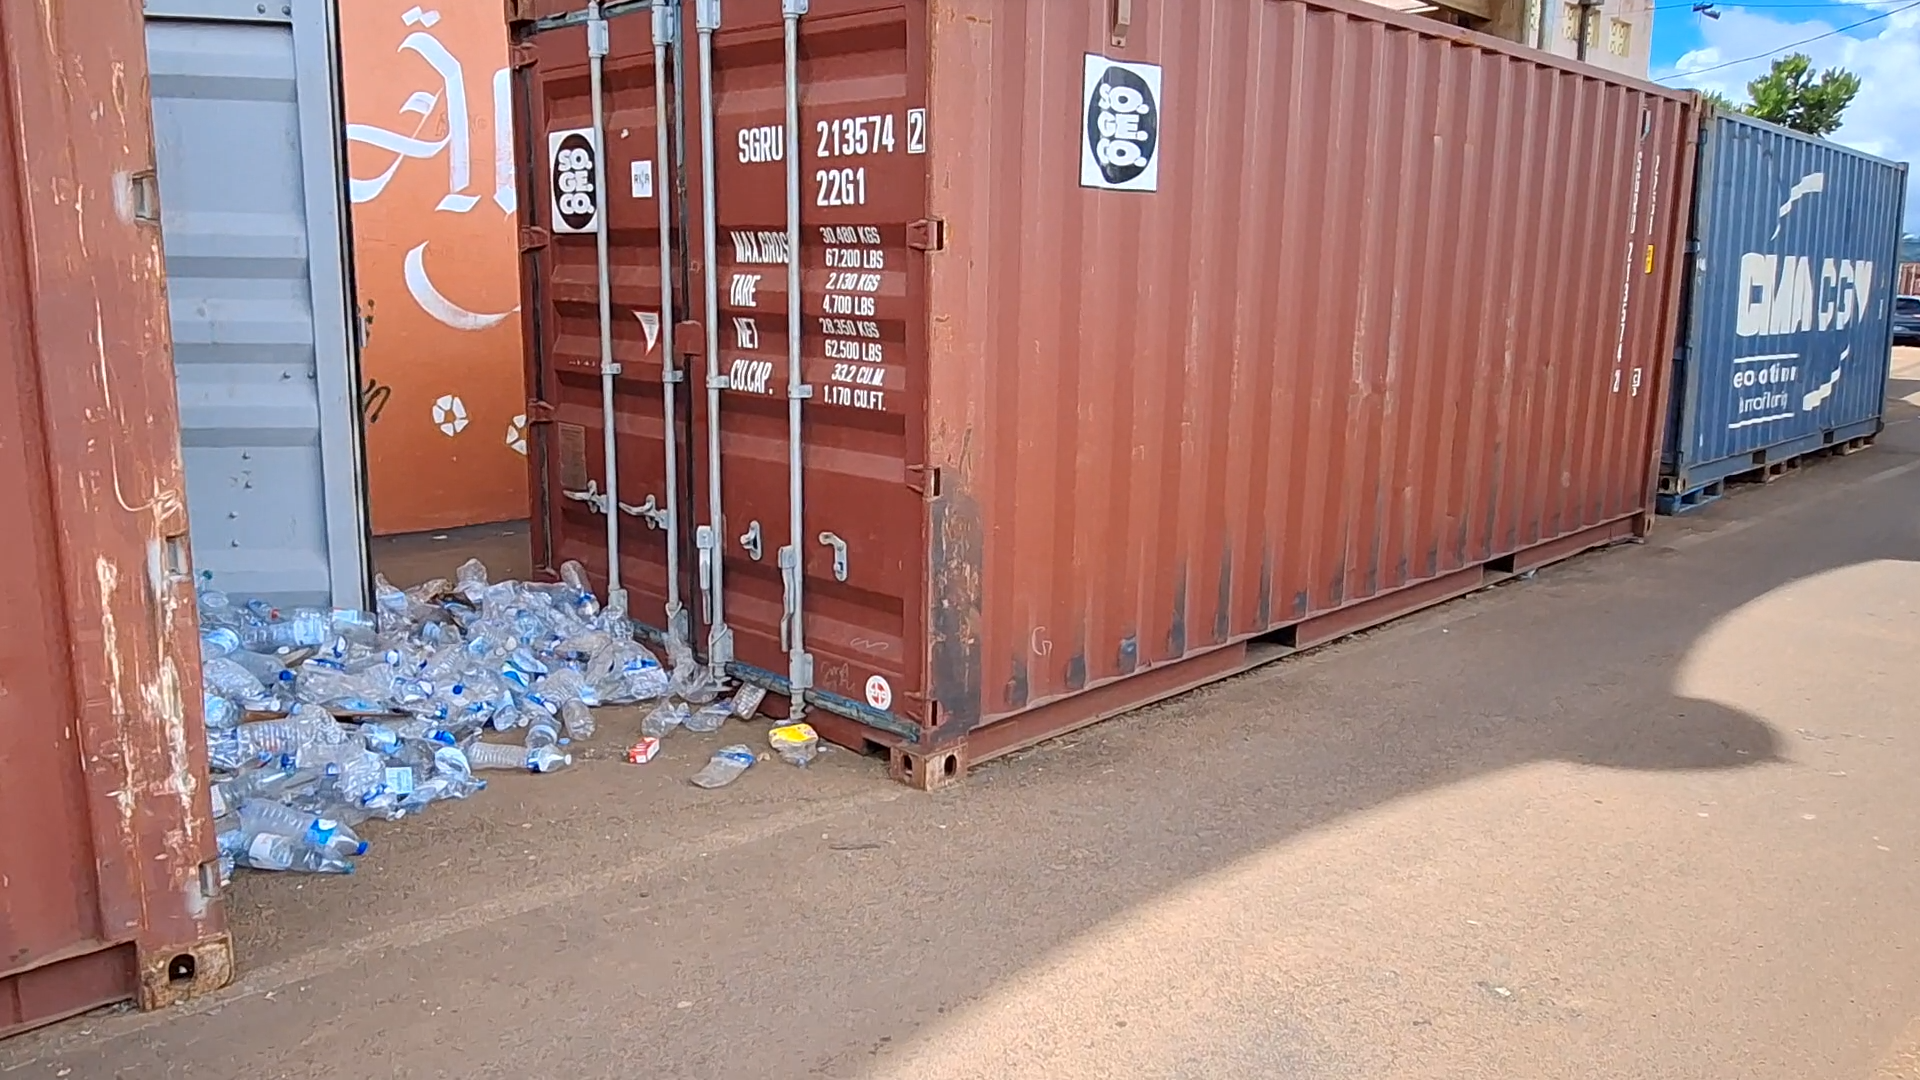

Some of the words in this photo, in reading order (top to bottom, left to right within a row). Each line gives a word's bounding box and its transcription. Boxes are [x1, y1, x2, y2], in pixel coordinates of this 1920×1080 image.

[738, 125, 783, 163] SGRU
[816, 113, 895, 158] 213574
[909, 111, 924, 152] 2
[816, 167, 865, 206] 22G1
[730, 231, 790, 264] MAX.GROS
[858, 226, 881, 245] KGS
[863, 249, 884, 269] LBS
[730, 274, 761, 307] TARE
[857, 273, 881, 292] KGS
[854, 296, 875, 316] LBS
[732, 317, 759, 349] NET
[857, 321, 880, 339] KGS
[862, 342, 882, 363] LBS
